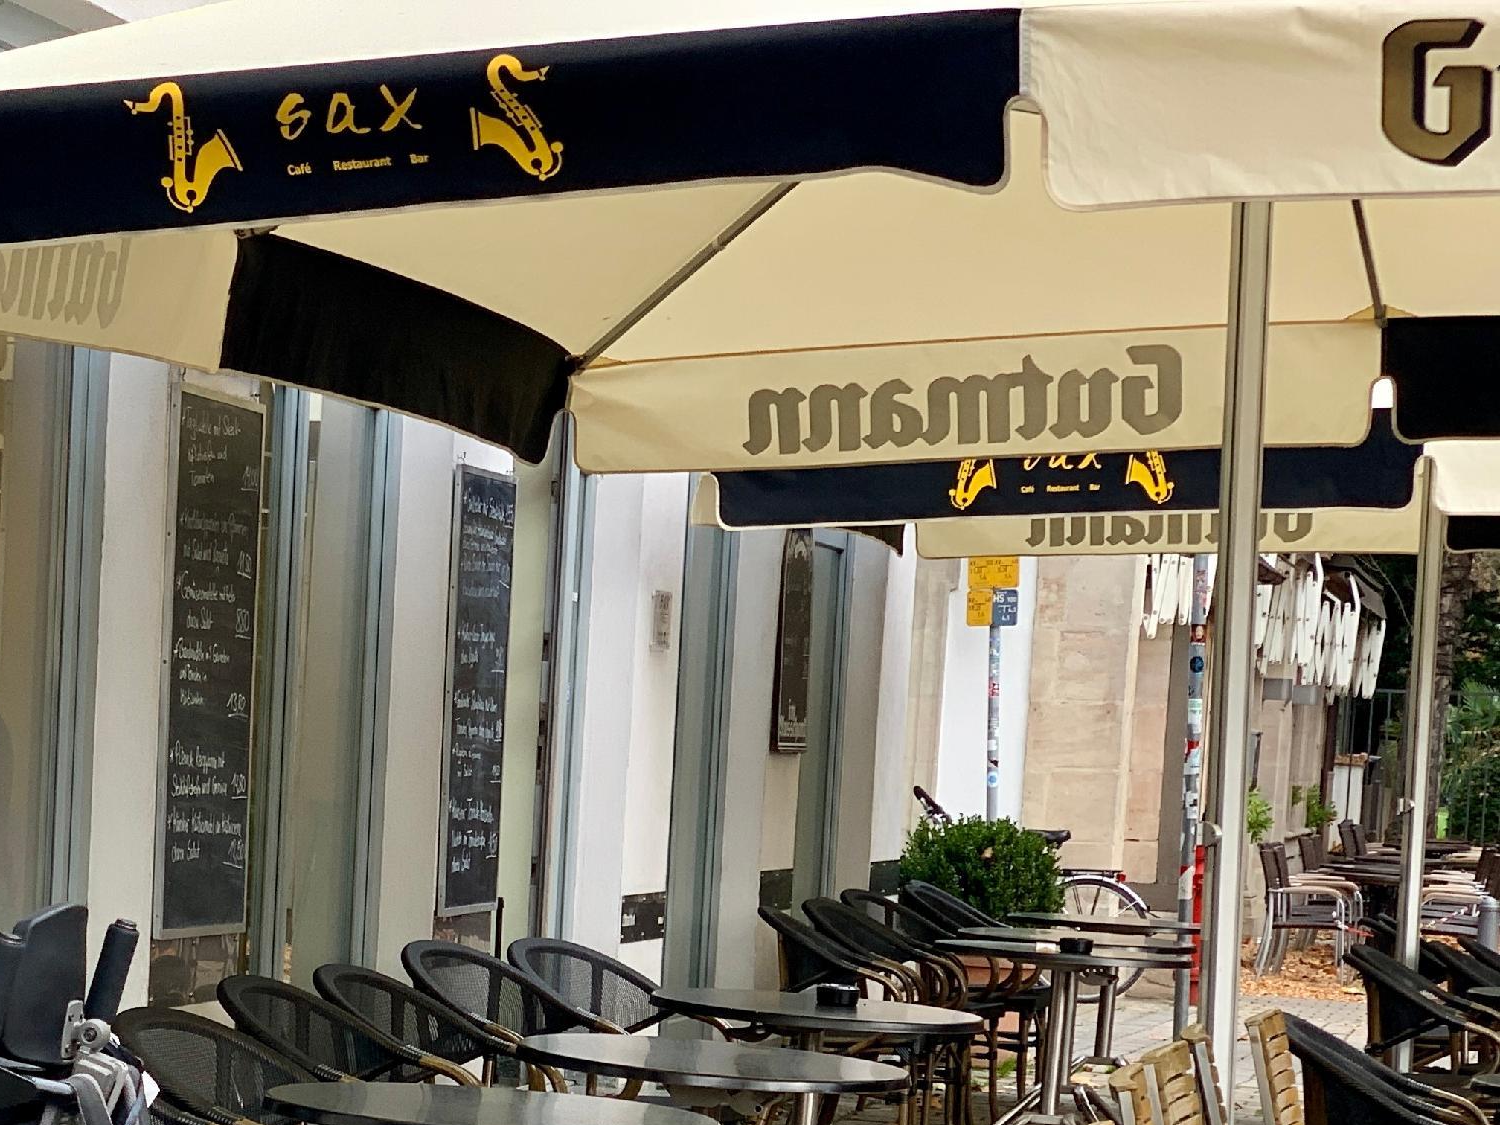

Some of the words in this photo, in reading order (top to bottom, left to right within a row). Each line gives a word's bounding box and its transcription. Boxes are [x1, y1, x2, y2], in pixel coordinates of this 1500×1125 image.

[276, 84, 422, 140] sax
[287, 162, 312, 176] Café
[333, 156, 392, 171] Restaurant
[410, 153, 429, 165] Bar
